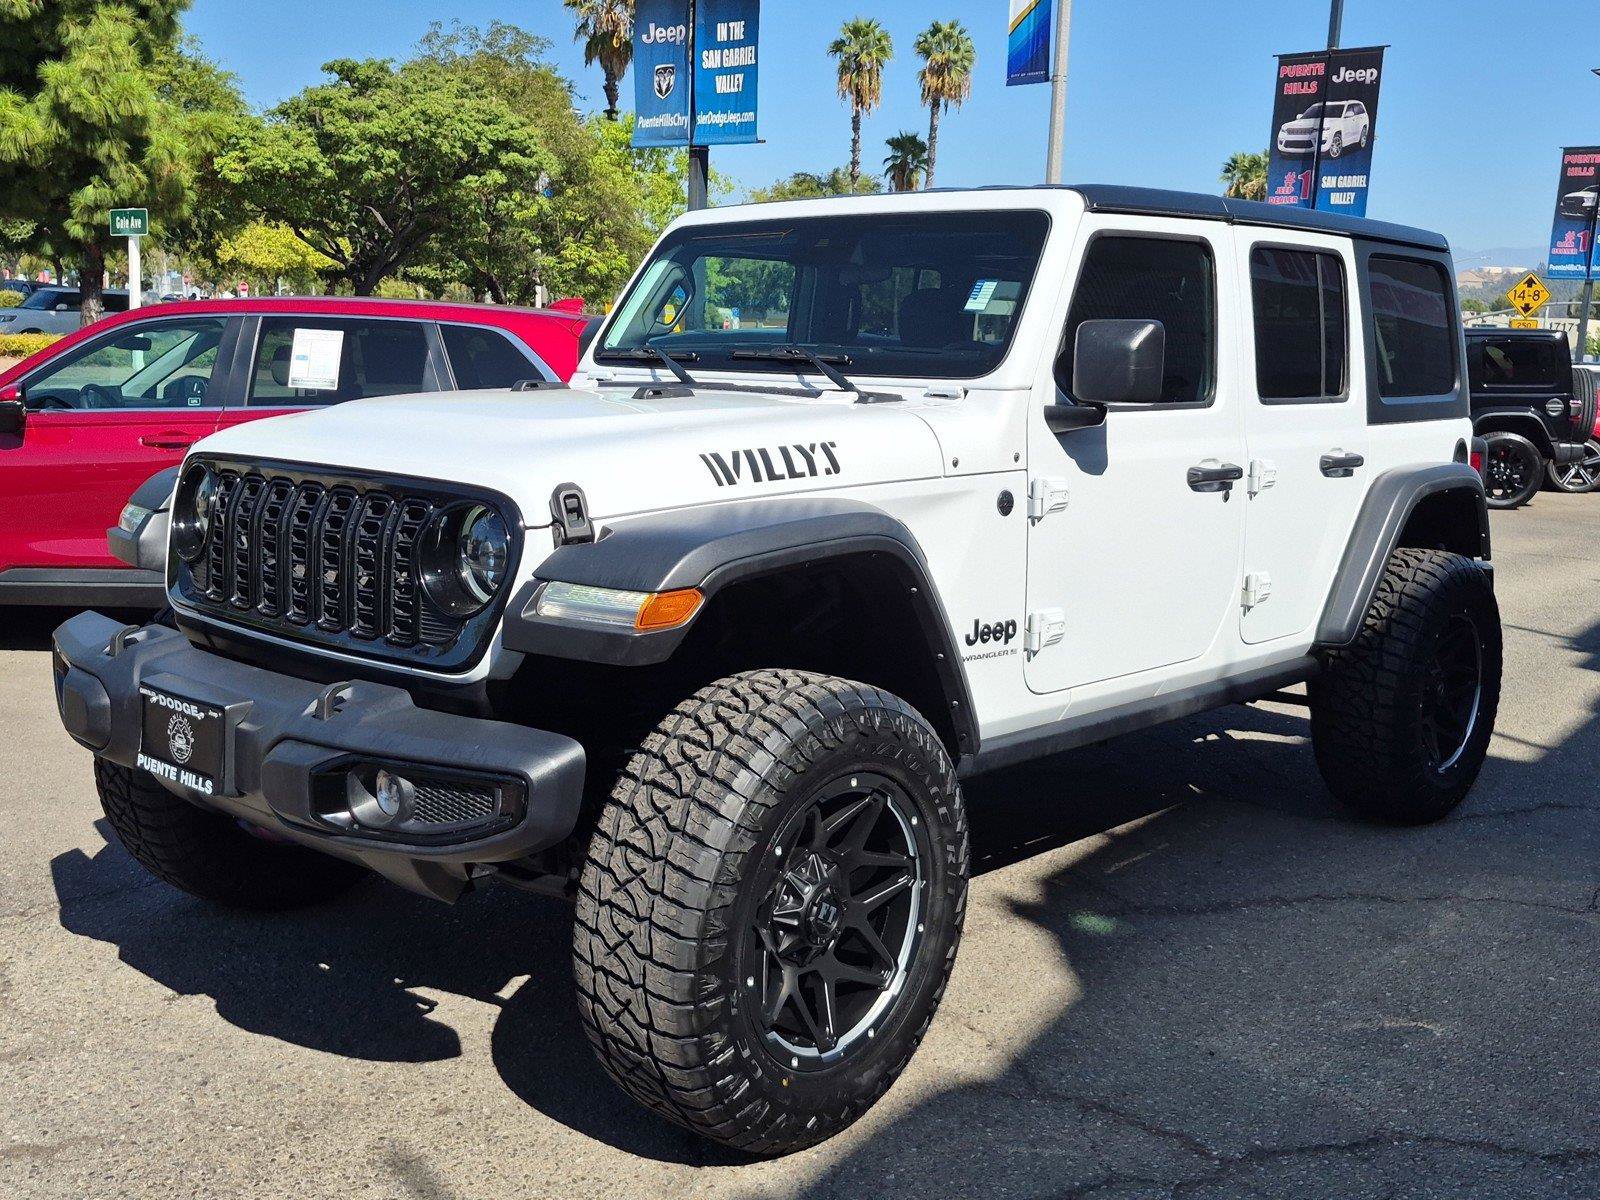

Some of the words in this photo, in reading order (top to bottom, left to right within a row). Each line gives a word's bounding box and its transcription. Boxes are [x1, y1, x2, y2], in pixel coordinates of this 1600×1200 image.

[641, 22, 686, 45] Jeep
[717, 22, 728, 42] IN
[729, 20, 745, 40] THE
[702, 49, 721, 69] SAN
[723, 45, 756, 67] GABRIEL
[1280, 62, 1325, 78] PUENTE
[1332, 66, 1378, 84] Jeep
[715, 73, 744, 94] VALLEY
[1284, 81, 1318, 95] HILLS
[1321, 176, 1337, 188] SAN
[1337, 175, 1367, 188] GABRIEL
[1567, 166, 1595, 176] HILLS
[1330, 192, 1356, 205] VALLEY
[698, 441, 841, 487] WILLYS
[964, 618, 1017, 647] Jeep
[962, 650, 1009, 661] WRANGLER
[159, 694, 198, 717] DODGE
[137, 754, 178, 780] PUENTE
[180, 770, 213, 794] HILLS
